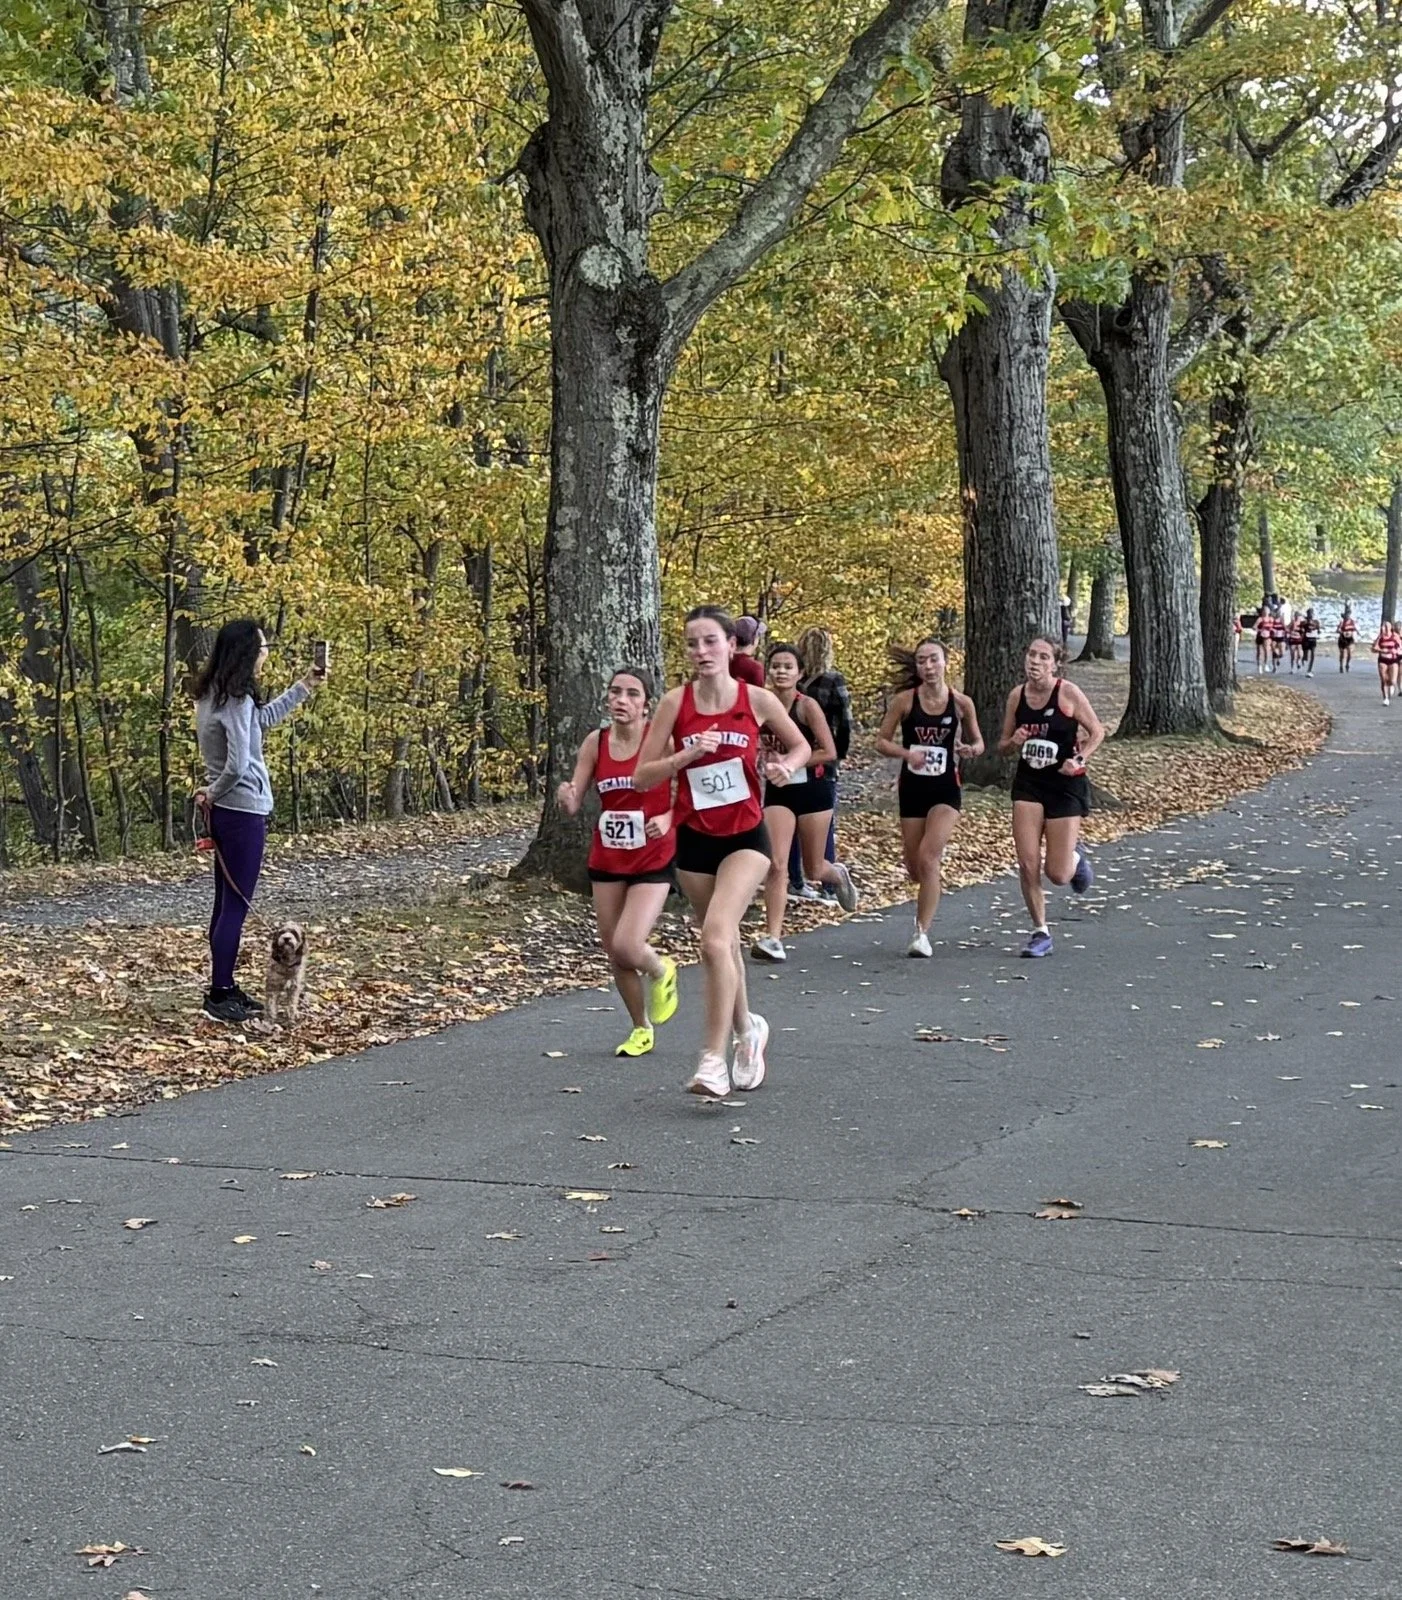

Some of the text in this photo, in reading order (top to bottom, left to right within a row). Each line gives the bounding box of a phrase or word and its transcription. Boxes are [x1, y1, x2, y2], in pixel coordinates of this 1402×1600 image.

[914, 727, 951, 745] W
[701, 771, 736, 794] 501
[605, 820, 635, 839] 521
